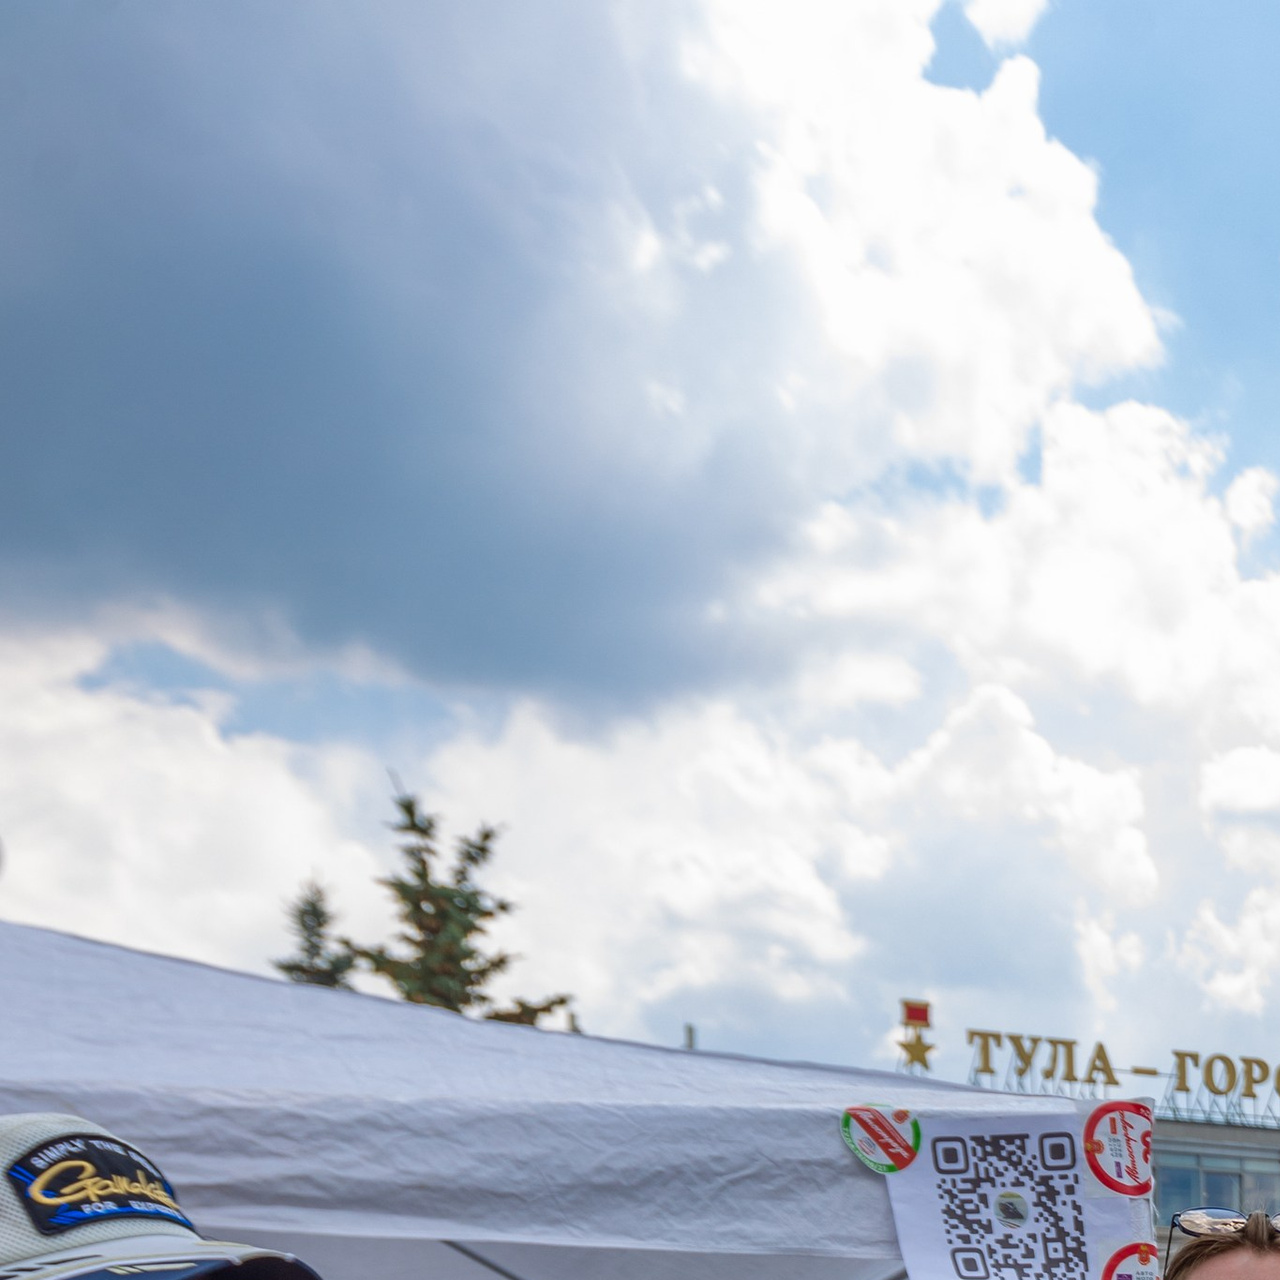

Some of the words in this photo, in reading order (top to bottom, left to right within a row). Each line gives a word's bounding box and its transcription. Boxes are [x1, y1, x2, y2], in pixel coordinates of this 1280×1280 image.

[966, 1028, 1120, 1086] ТУЛА
[30, 1139, 87, 1169] SIMPLY
[88, 1140, 128, 1156] THE
[81, 1200, 118, 1215] FOR
